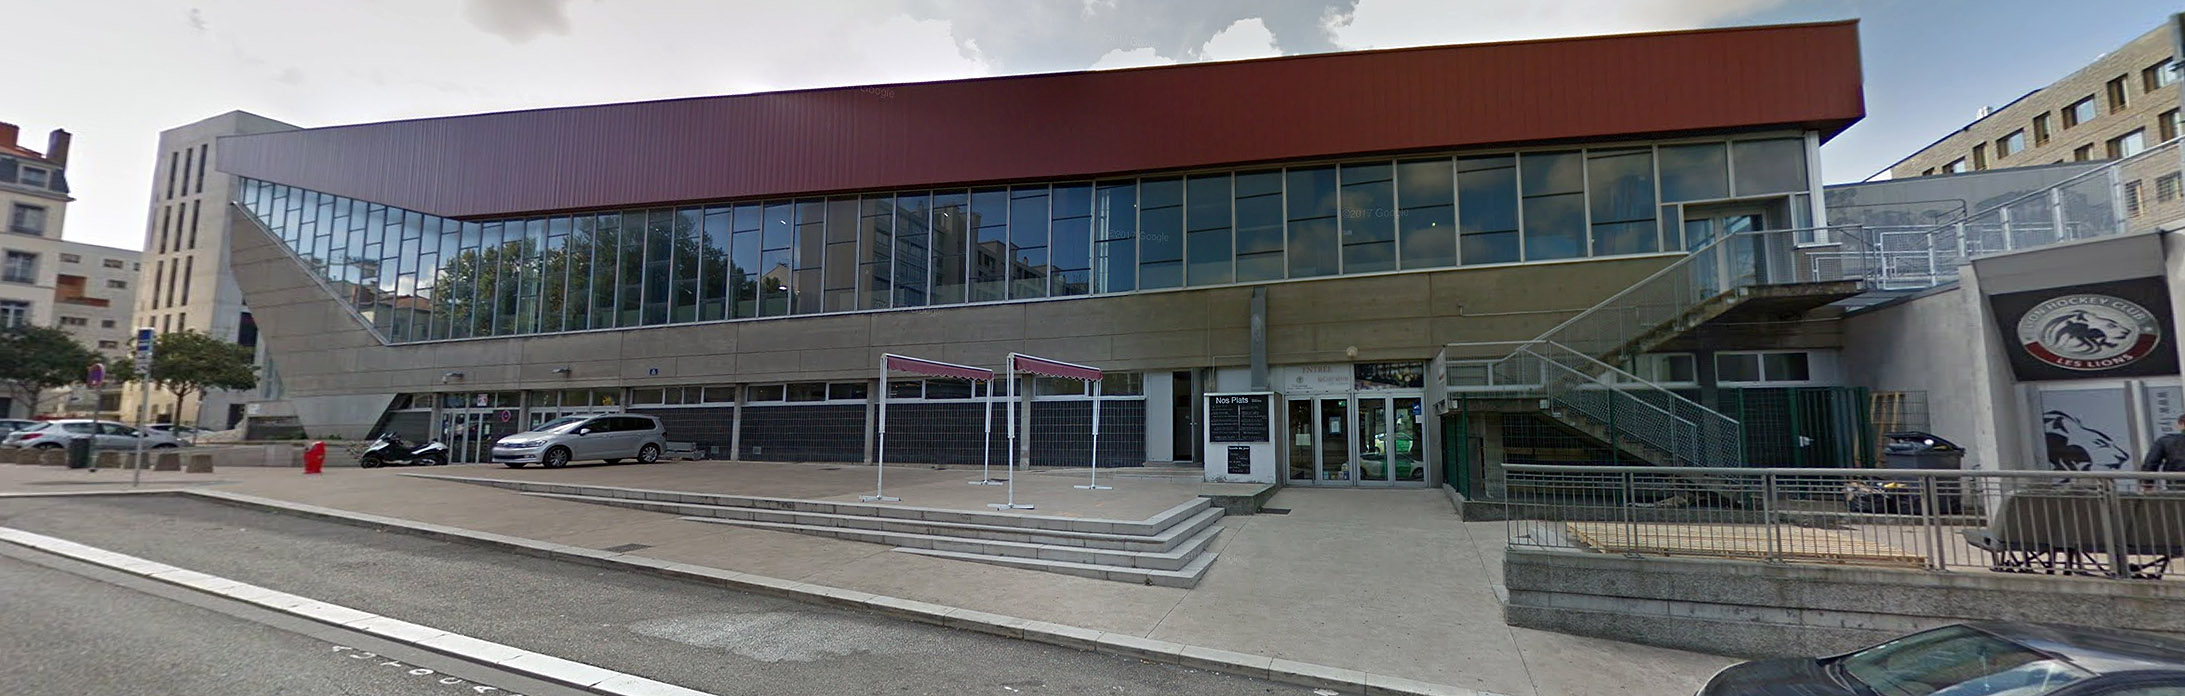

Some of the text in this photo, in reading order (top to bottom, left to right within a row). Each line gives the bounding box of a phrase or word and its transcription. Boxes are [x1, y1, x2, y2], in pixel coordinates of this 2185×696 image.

[2046, 296, 2109, 311] HOCKEY
[2112, 300, 2147, 320] CLUB
[2056, 354, 2134, 368] LES LIONS
[1231, 396, 1249, 404] Plats
